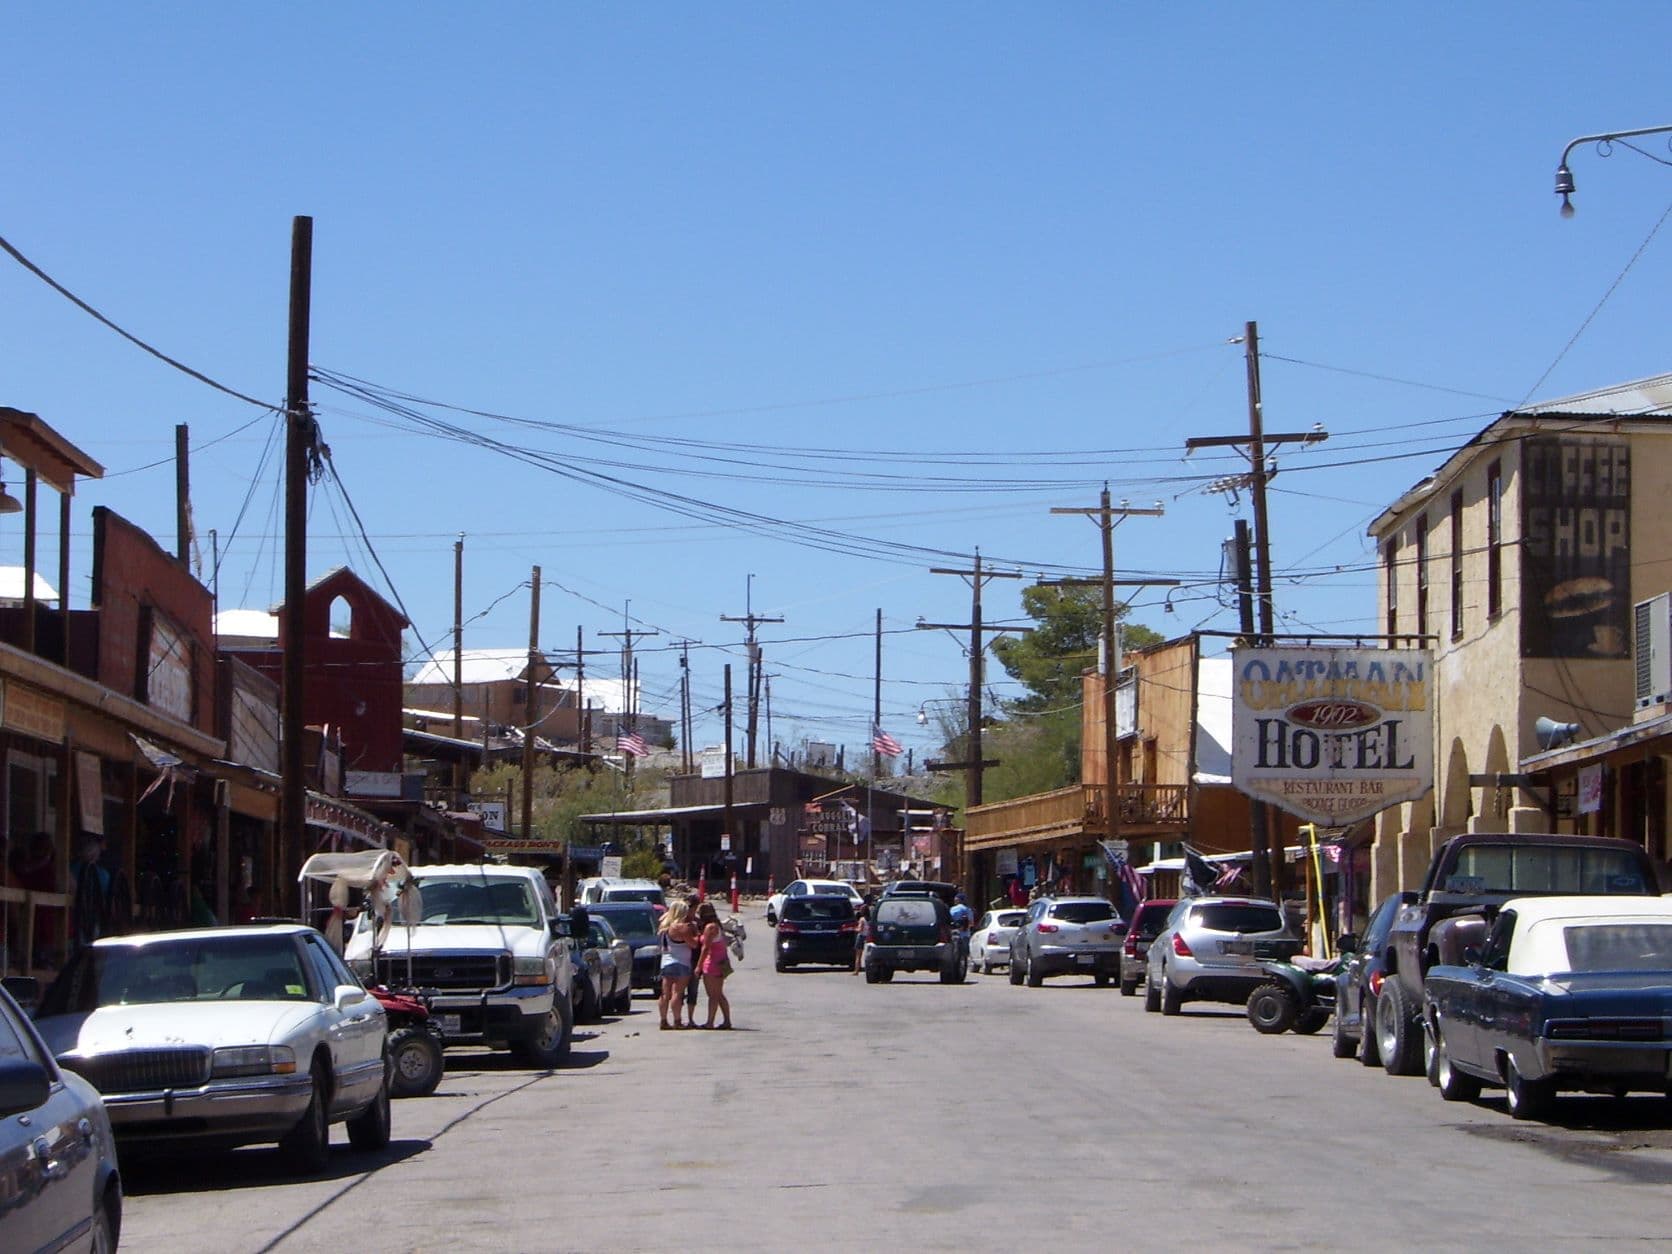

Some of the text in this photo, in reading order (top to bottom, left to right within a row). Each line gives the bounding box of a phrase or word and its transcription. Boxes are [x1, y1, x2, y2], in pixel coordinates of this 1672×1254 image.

[1527, 508, 1628, 557] SHOP
[1242, 659, 1426, 711] OATMAN
[1310, 706, 1358, 725] 1902
[1254, 718, 1415, 770] HOTEL
[1283, 780, 1384, 795] RESTAURANT BAR
